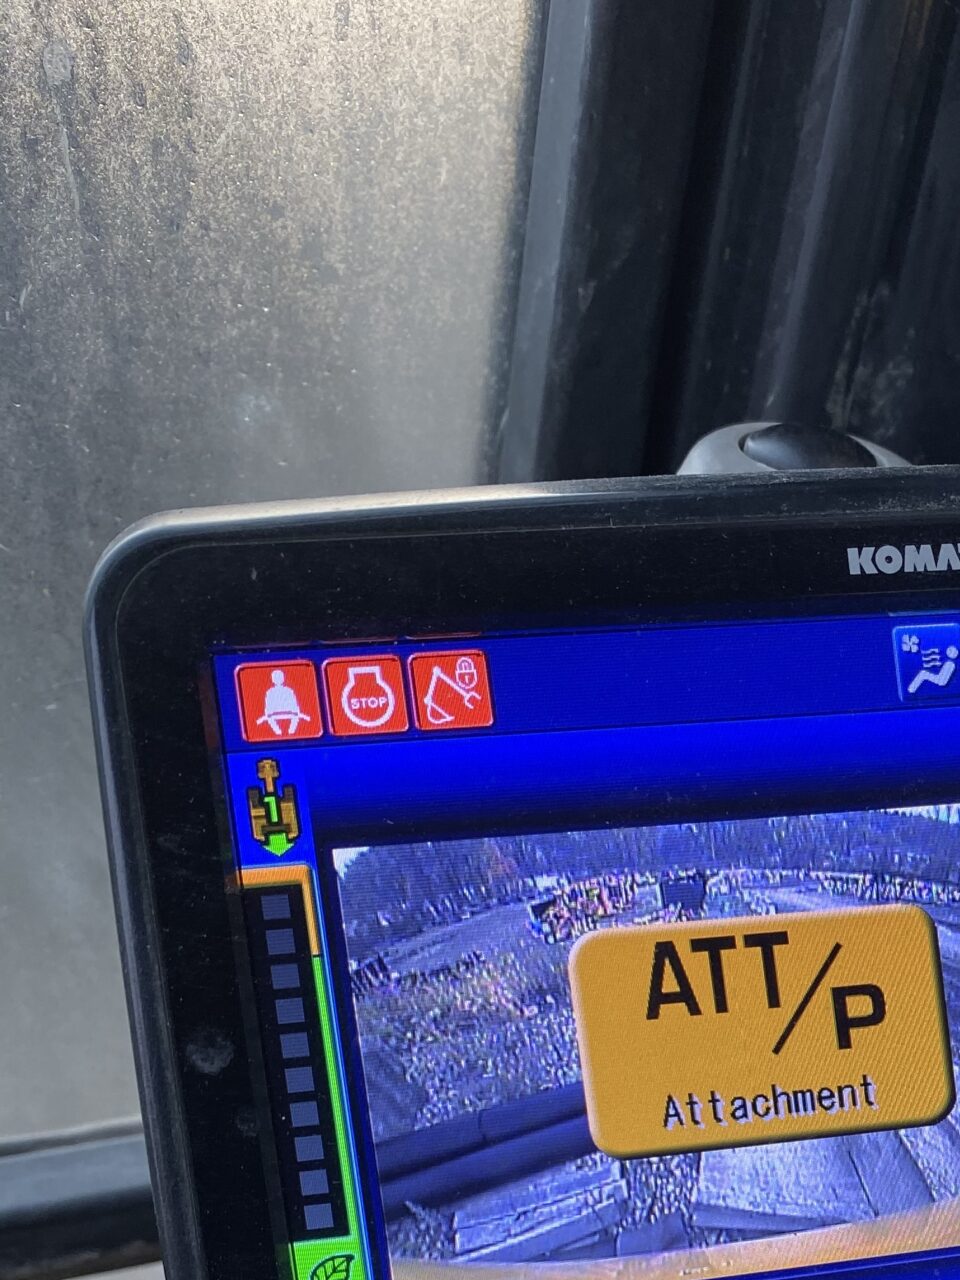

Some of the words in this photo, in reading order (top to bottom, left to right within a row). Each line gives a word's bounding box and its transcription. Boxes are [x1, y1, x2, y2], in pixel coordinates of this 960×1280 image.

[349, 696, 388, 711] STOP
[264, 796, 280, 823] 1
[645, 930, 887, 1056] ATT/P
[662, 1073, 878, 1129] Attachment
